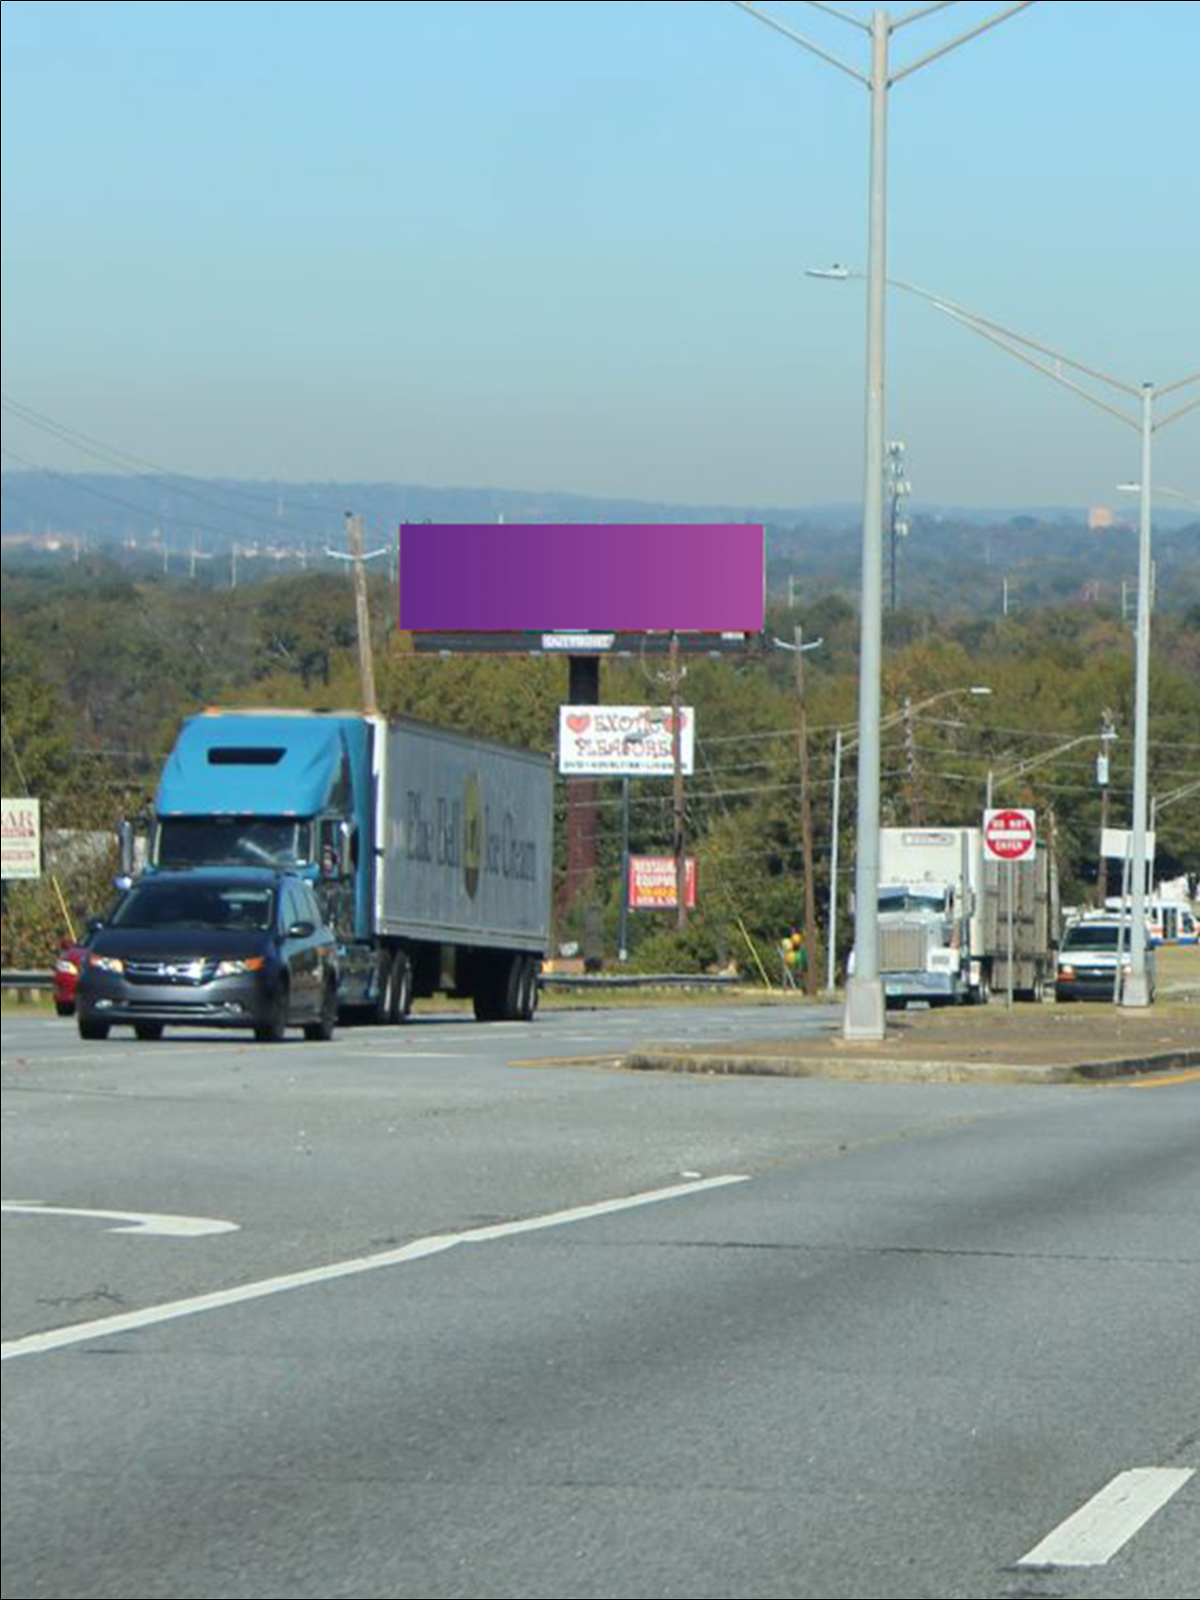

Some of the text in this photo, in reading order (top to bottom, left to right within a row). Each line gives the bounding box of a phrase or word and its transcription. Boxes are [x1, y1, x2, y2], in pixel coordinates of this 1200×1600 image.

[595, 713, 661, 734] EXOTIC
[992, 819, 1027, 829] DO NOT
[406, 790, 432, 862] Blue
[437, 797, 461, 868] Bell
[503, 811, 537, 882] Cream
[995, 839, 1022, 851] ENTER
